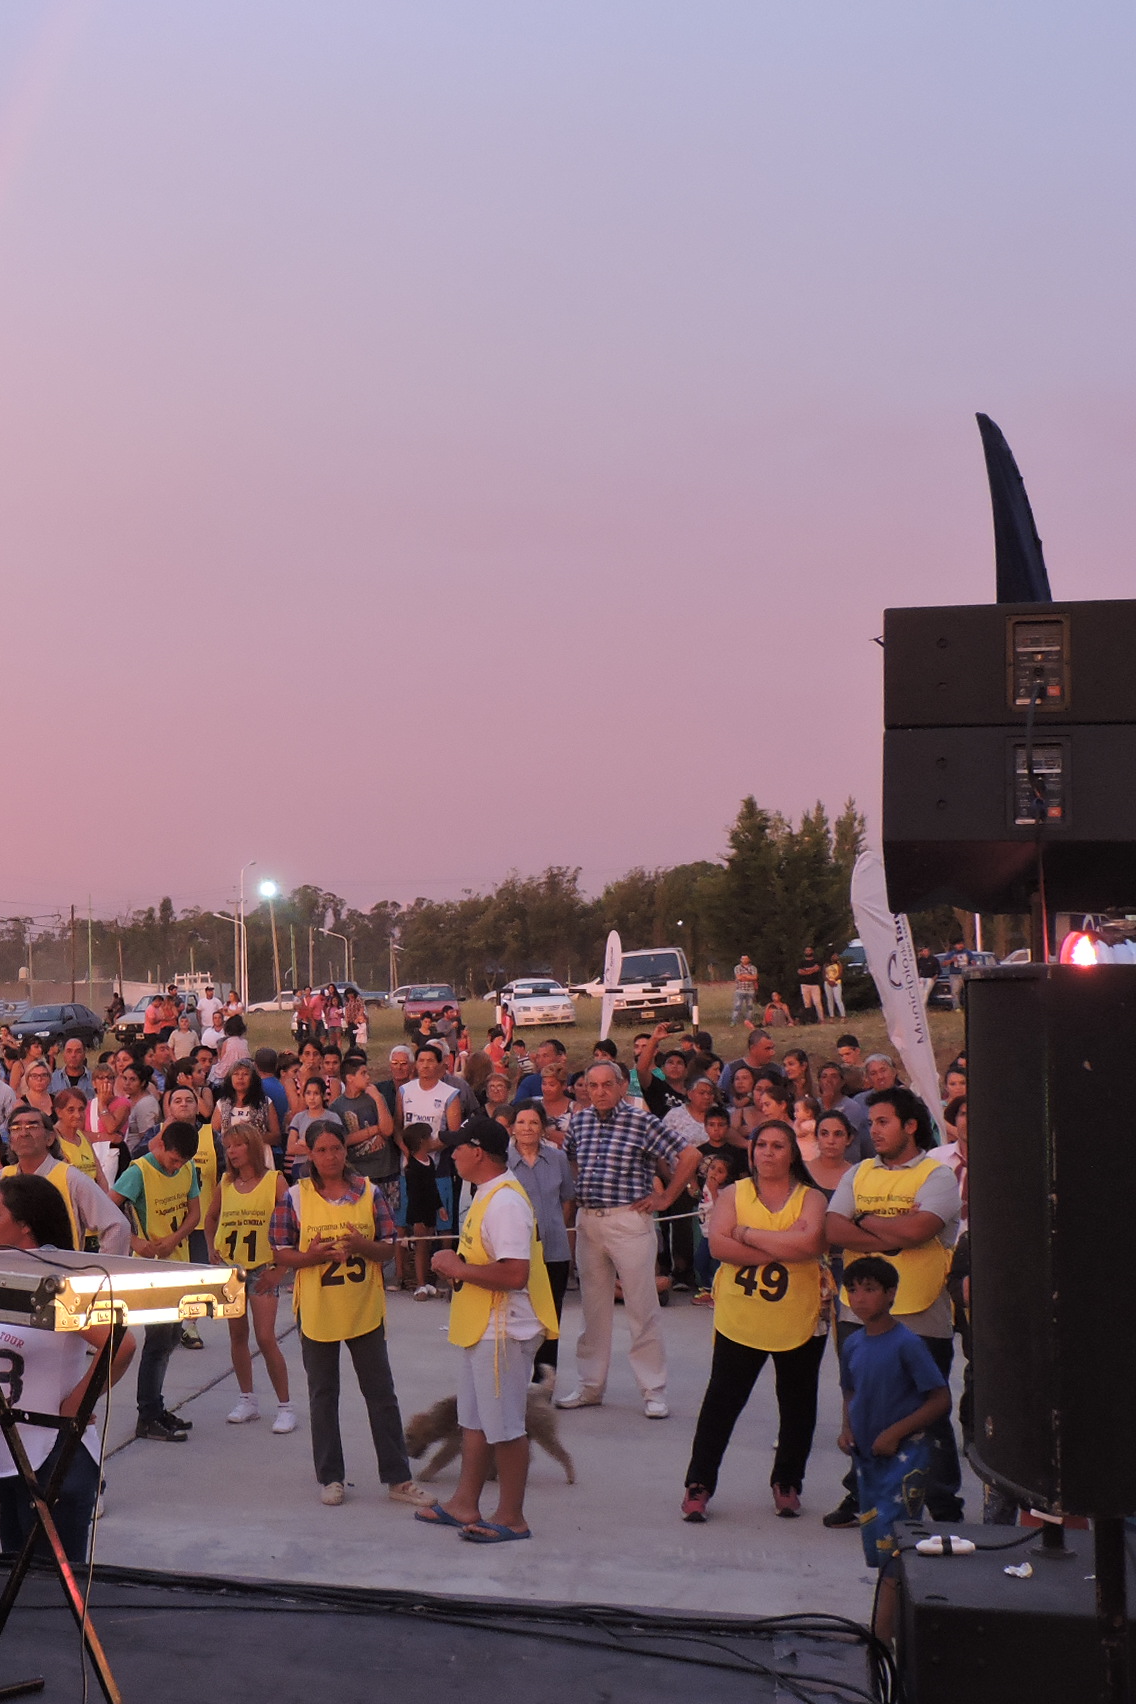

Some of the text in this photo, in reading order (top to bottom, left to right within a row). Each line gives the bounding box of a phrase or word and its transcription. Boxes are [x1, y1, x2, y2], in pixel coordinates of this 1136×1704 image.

[307, 1223, 338, 1233] Programa
[225, 1230, 257, 1262] 11
[321, 1256, 366, 1287] 25
[735, 1262, 789, 1302] 49
[0, 1331, 25, 1349] TOUR
